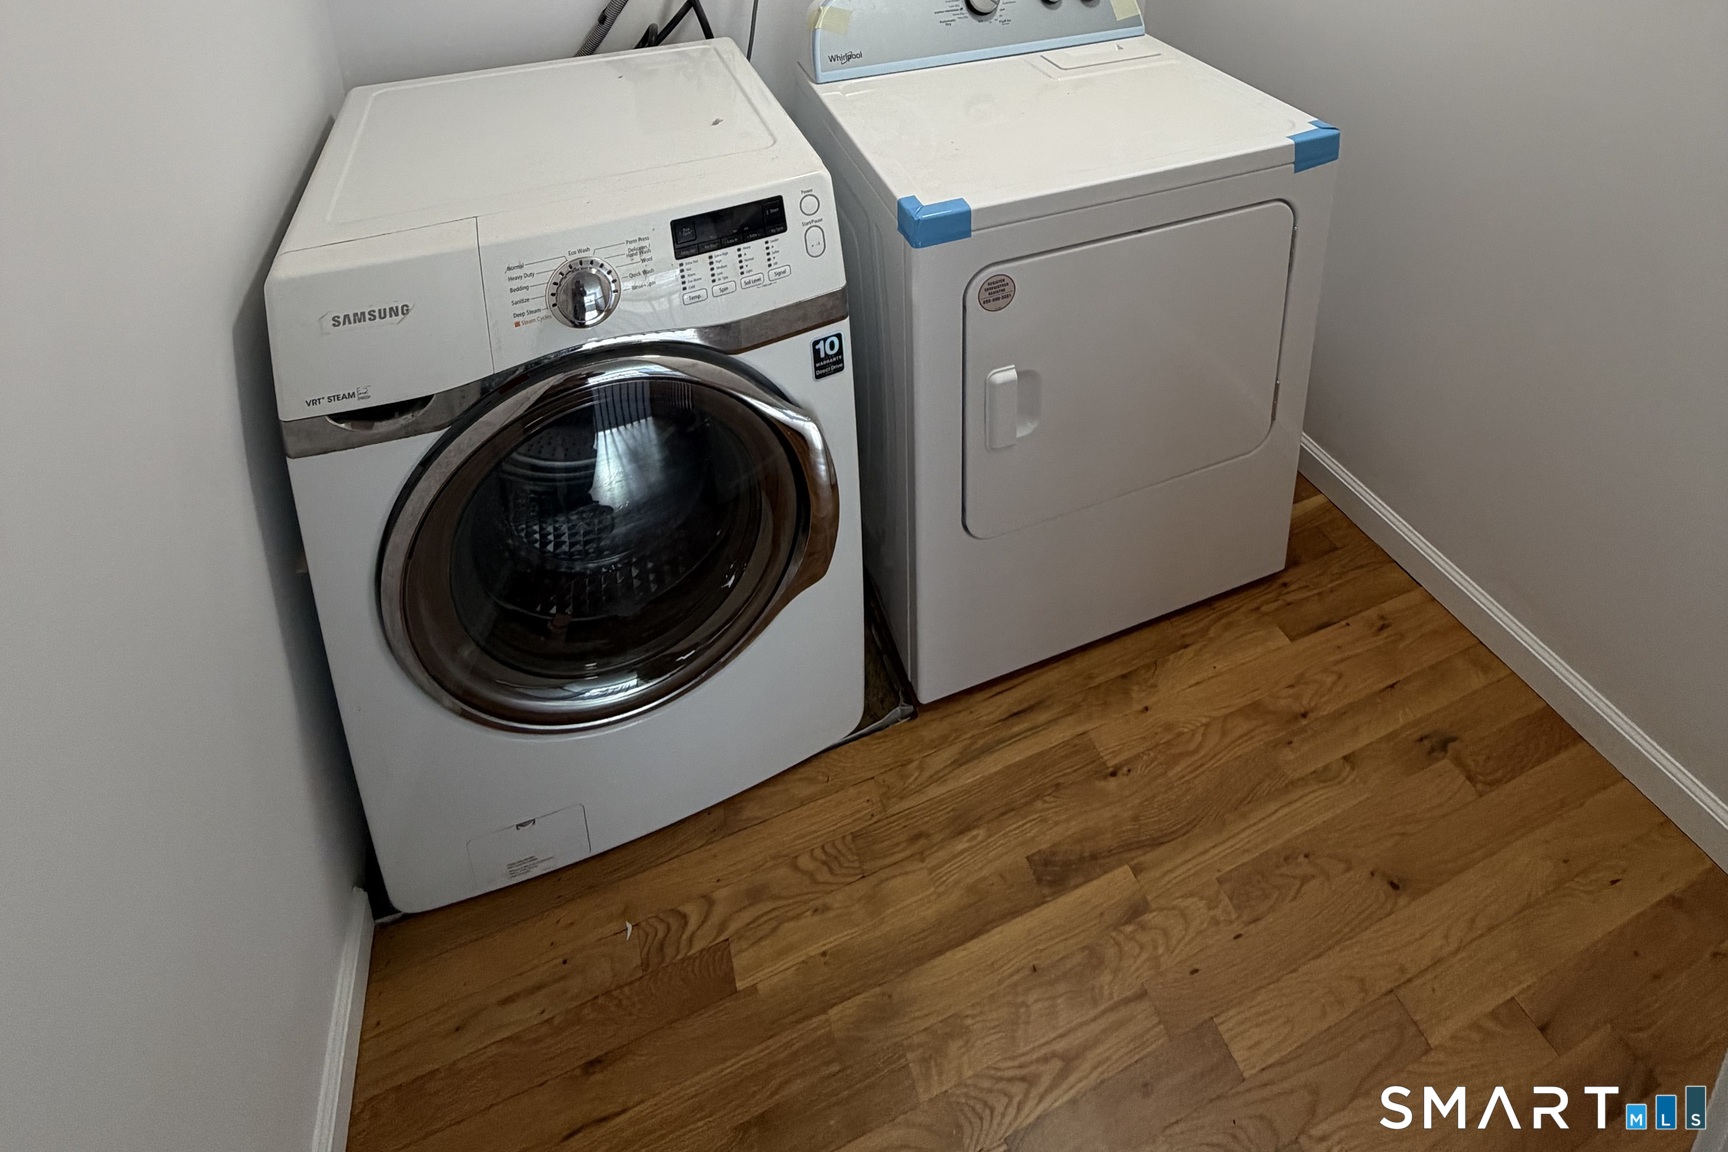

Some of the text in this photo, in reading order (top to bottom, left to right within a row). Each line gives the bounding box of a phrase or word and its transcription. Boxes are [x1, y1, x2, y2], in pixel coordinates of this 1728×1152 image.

[828, 50, 863, 65] Whirlpool
[568, 249, 576, 257] Eco
[508, 274, 523, 282] Heavy
[509, 285, 529, 293] Bedding
[331, 304, 410, 327] SAMSUNG
[815, 336, 840, 358] 10
[816, 355, 842, 367] WARRANTY
[830, 363, 843, 371] Drive
[327, 391, 356, 403] STEAM
